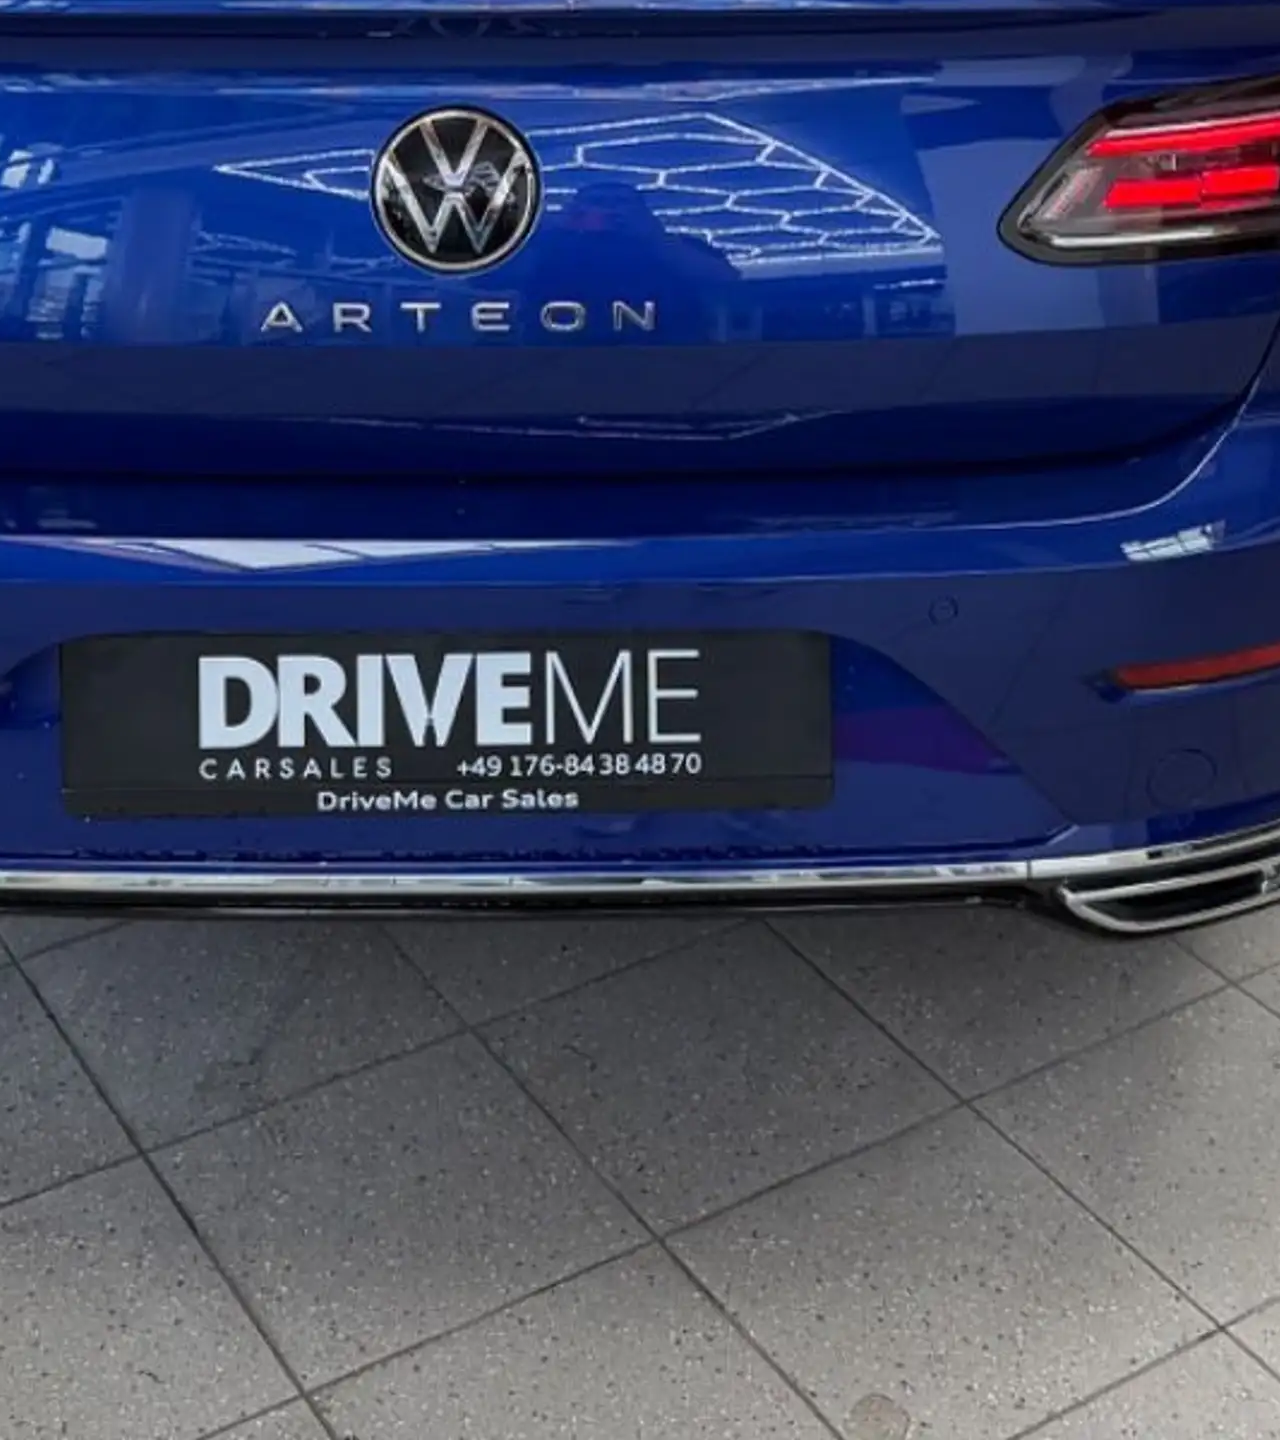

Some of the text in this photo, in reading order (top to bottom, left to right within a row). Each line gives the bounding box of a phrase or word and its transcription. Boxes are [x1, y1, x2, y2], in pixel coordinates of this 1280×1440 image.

[261, 300, 656, 333] ARTEON
[198, 649, 702, 748] DRIVEME
[198, 757, 393, 780] CARSALES
[457, 756, 503, 777] +49
[317, 787, 580, 811] DriveMe Car Sales
